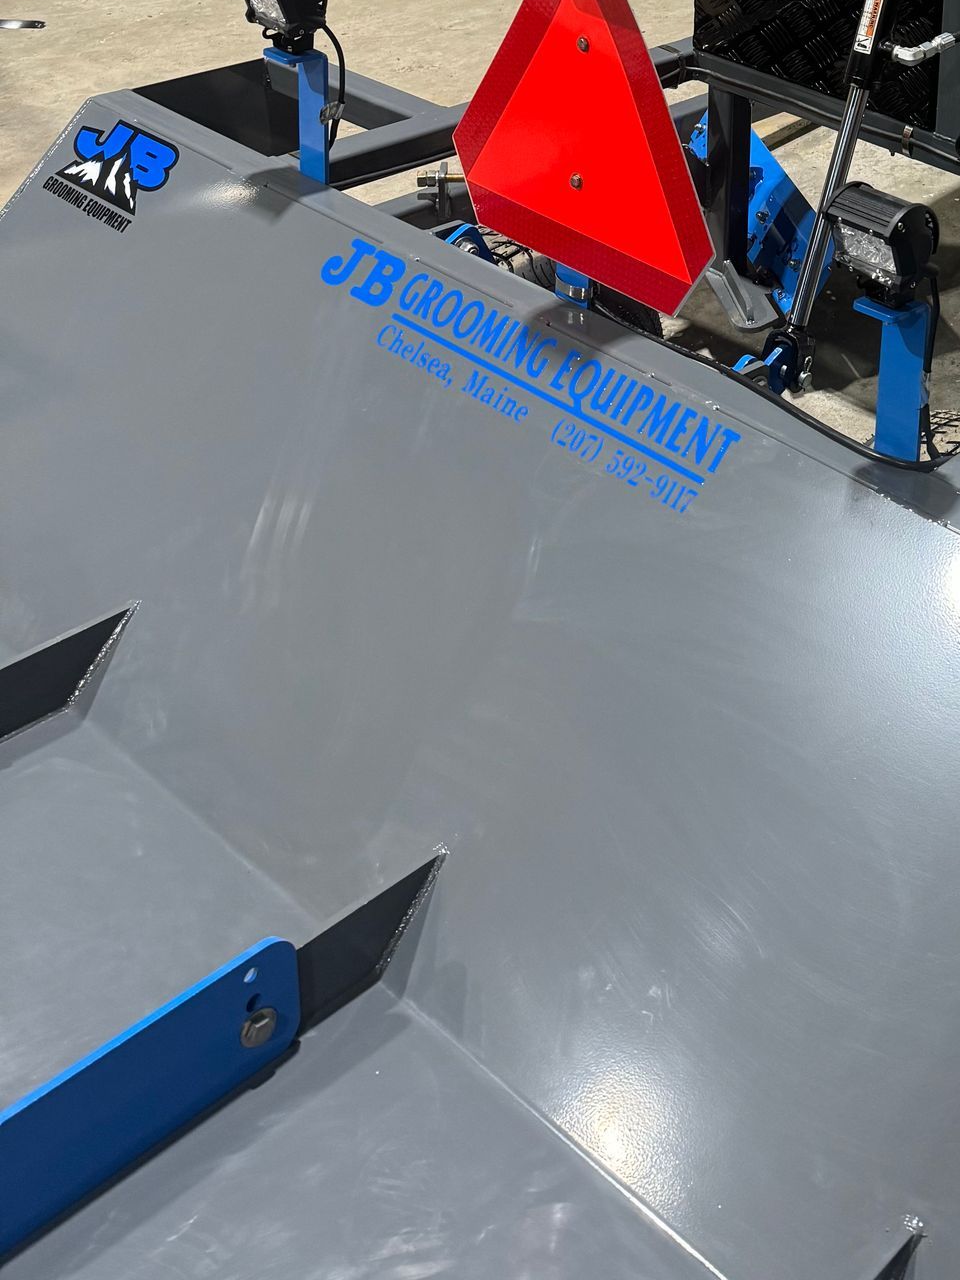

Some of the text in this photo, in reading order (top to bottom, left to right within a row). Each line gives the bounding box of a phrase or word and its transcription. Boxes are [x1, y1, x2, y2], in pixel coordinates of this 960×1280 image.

[42, 175, 132, 233] GROOMING EQUIPMENT
[75, 120, 178, 191] JB
[320, 238, 741, 474] JB GROOMING EQUIPMENT
[376, 323, 698, 514] Chelsea, Maine (207) 592-9117
